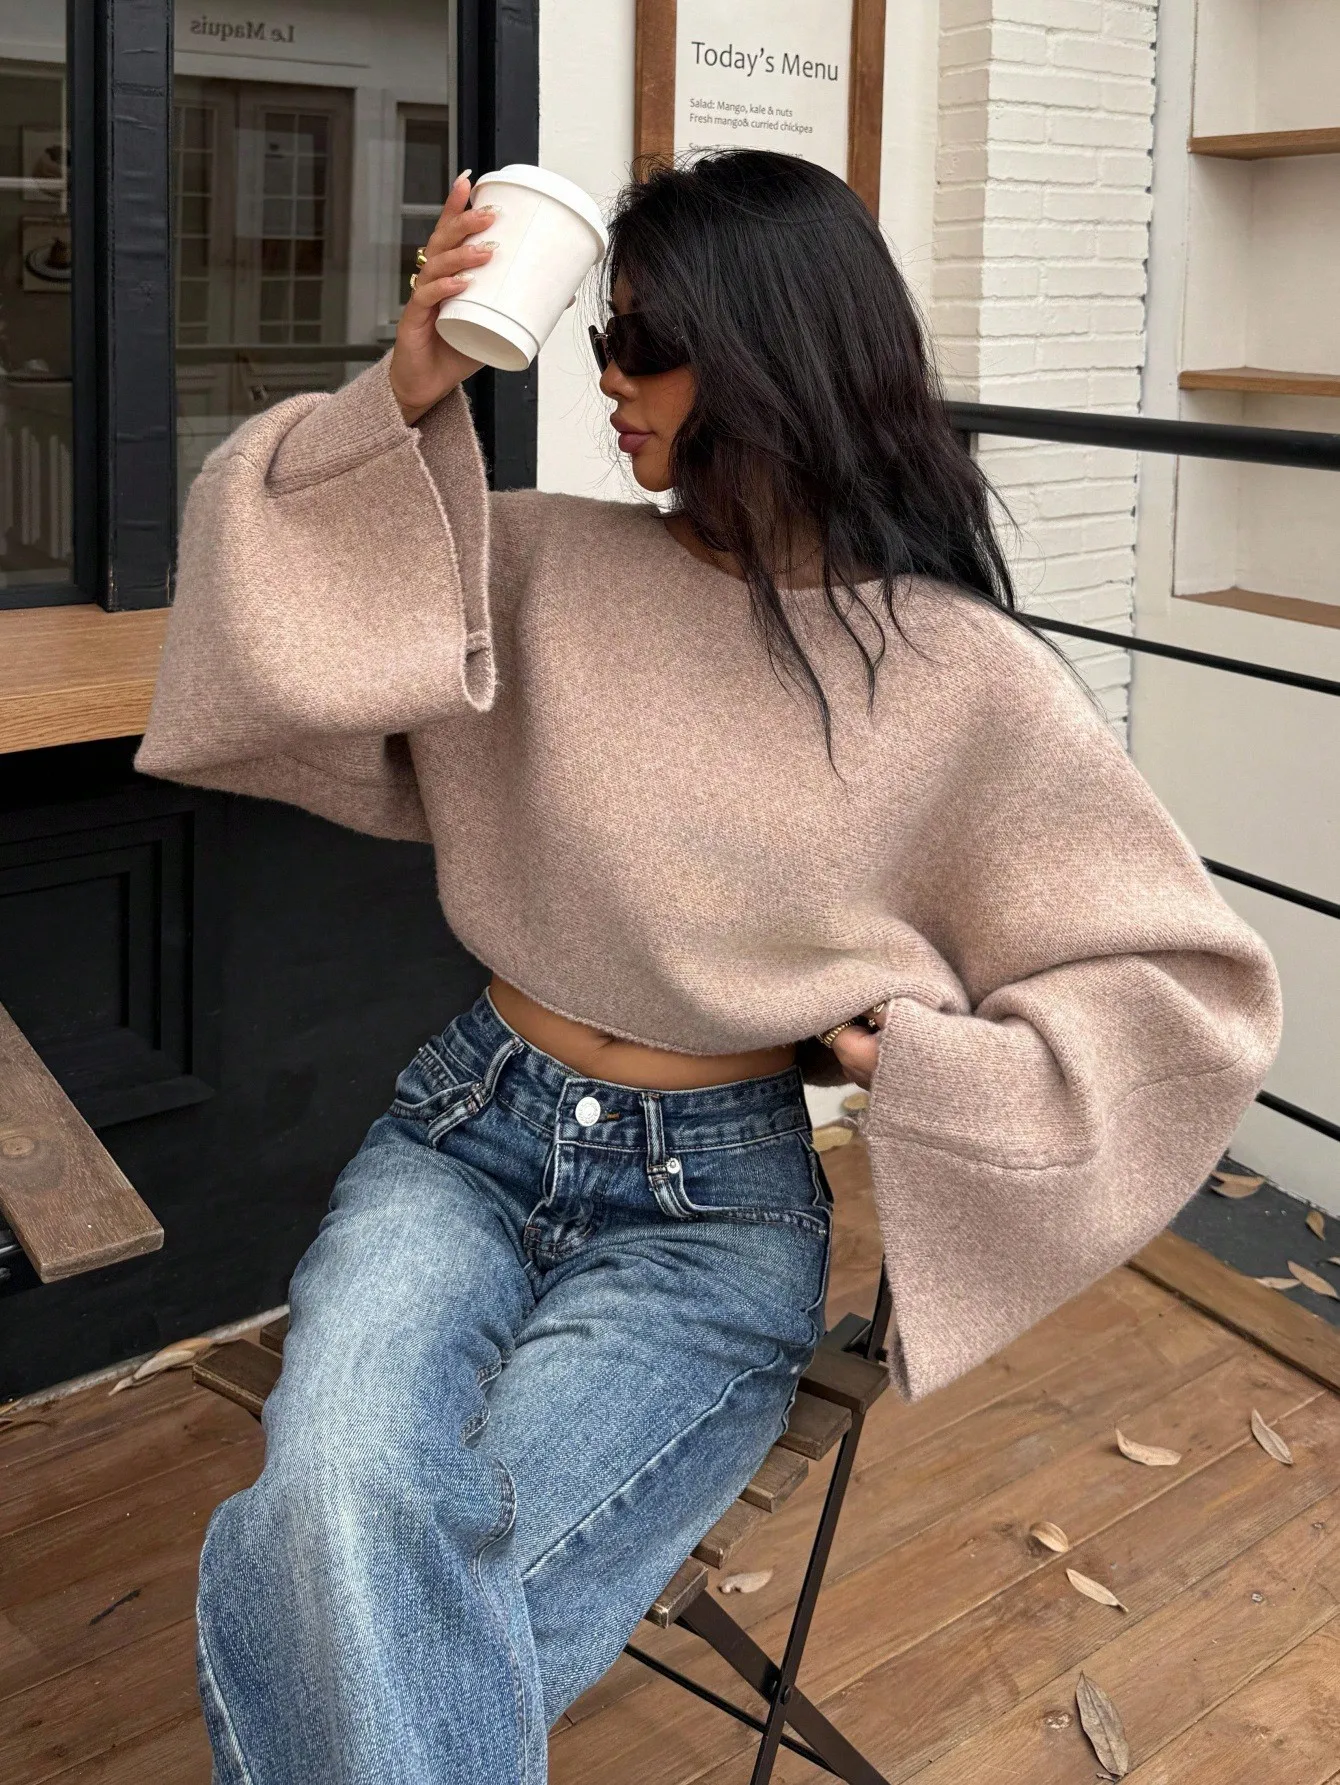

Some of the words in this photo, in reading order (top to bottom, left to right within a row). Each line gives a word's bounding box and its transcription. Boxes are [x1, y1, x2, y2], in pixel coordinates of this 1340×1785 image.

[691, 41, 775, 77] Today’s
[781, 52, 839, 81] Menu
[689, 98, 715, 110] Salad:
[716, 101, 748, 115] Mango,
[749, 103, 766, 115] kale
[767, 106, 774, 116] &
[775, 108, 793, 118] nuts
[689, 113, 713, 124] Fresh
[750, 120, 779, 131] curried
[780, 122, 813, 135] chickpea
